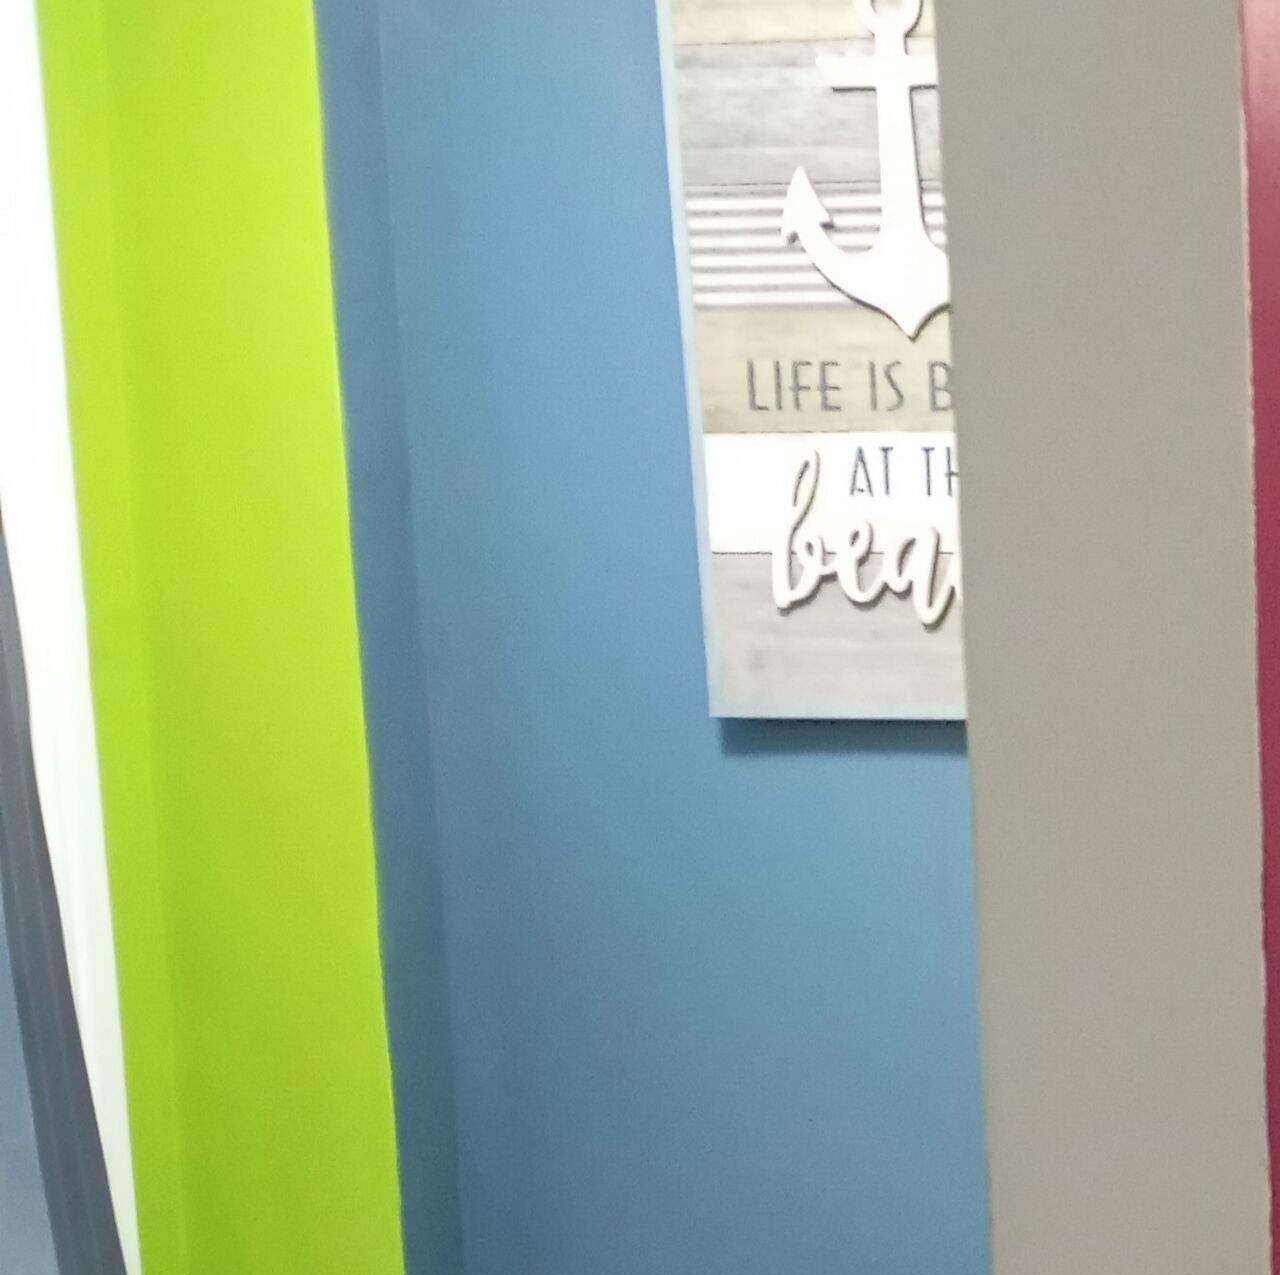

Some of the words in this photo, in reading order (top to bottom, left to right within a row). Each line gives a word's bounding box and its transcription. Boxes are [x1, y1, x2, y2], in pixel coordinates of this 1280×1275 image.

[747, 360, 842, 412] LIFE
[868, 360, 904, 412] IS
[849, 445, 893, 497] AT
